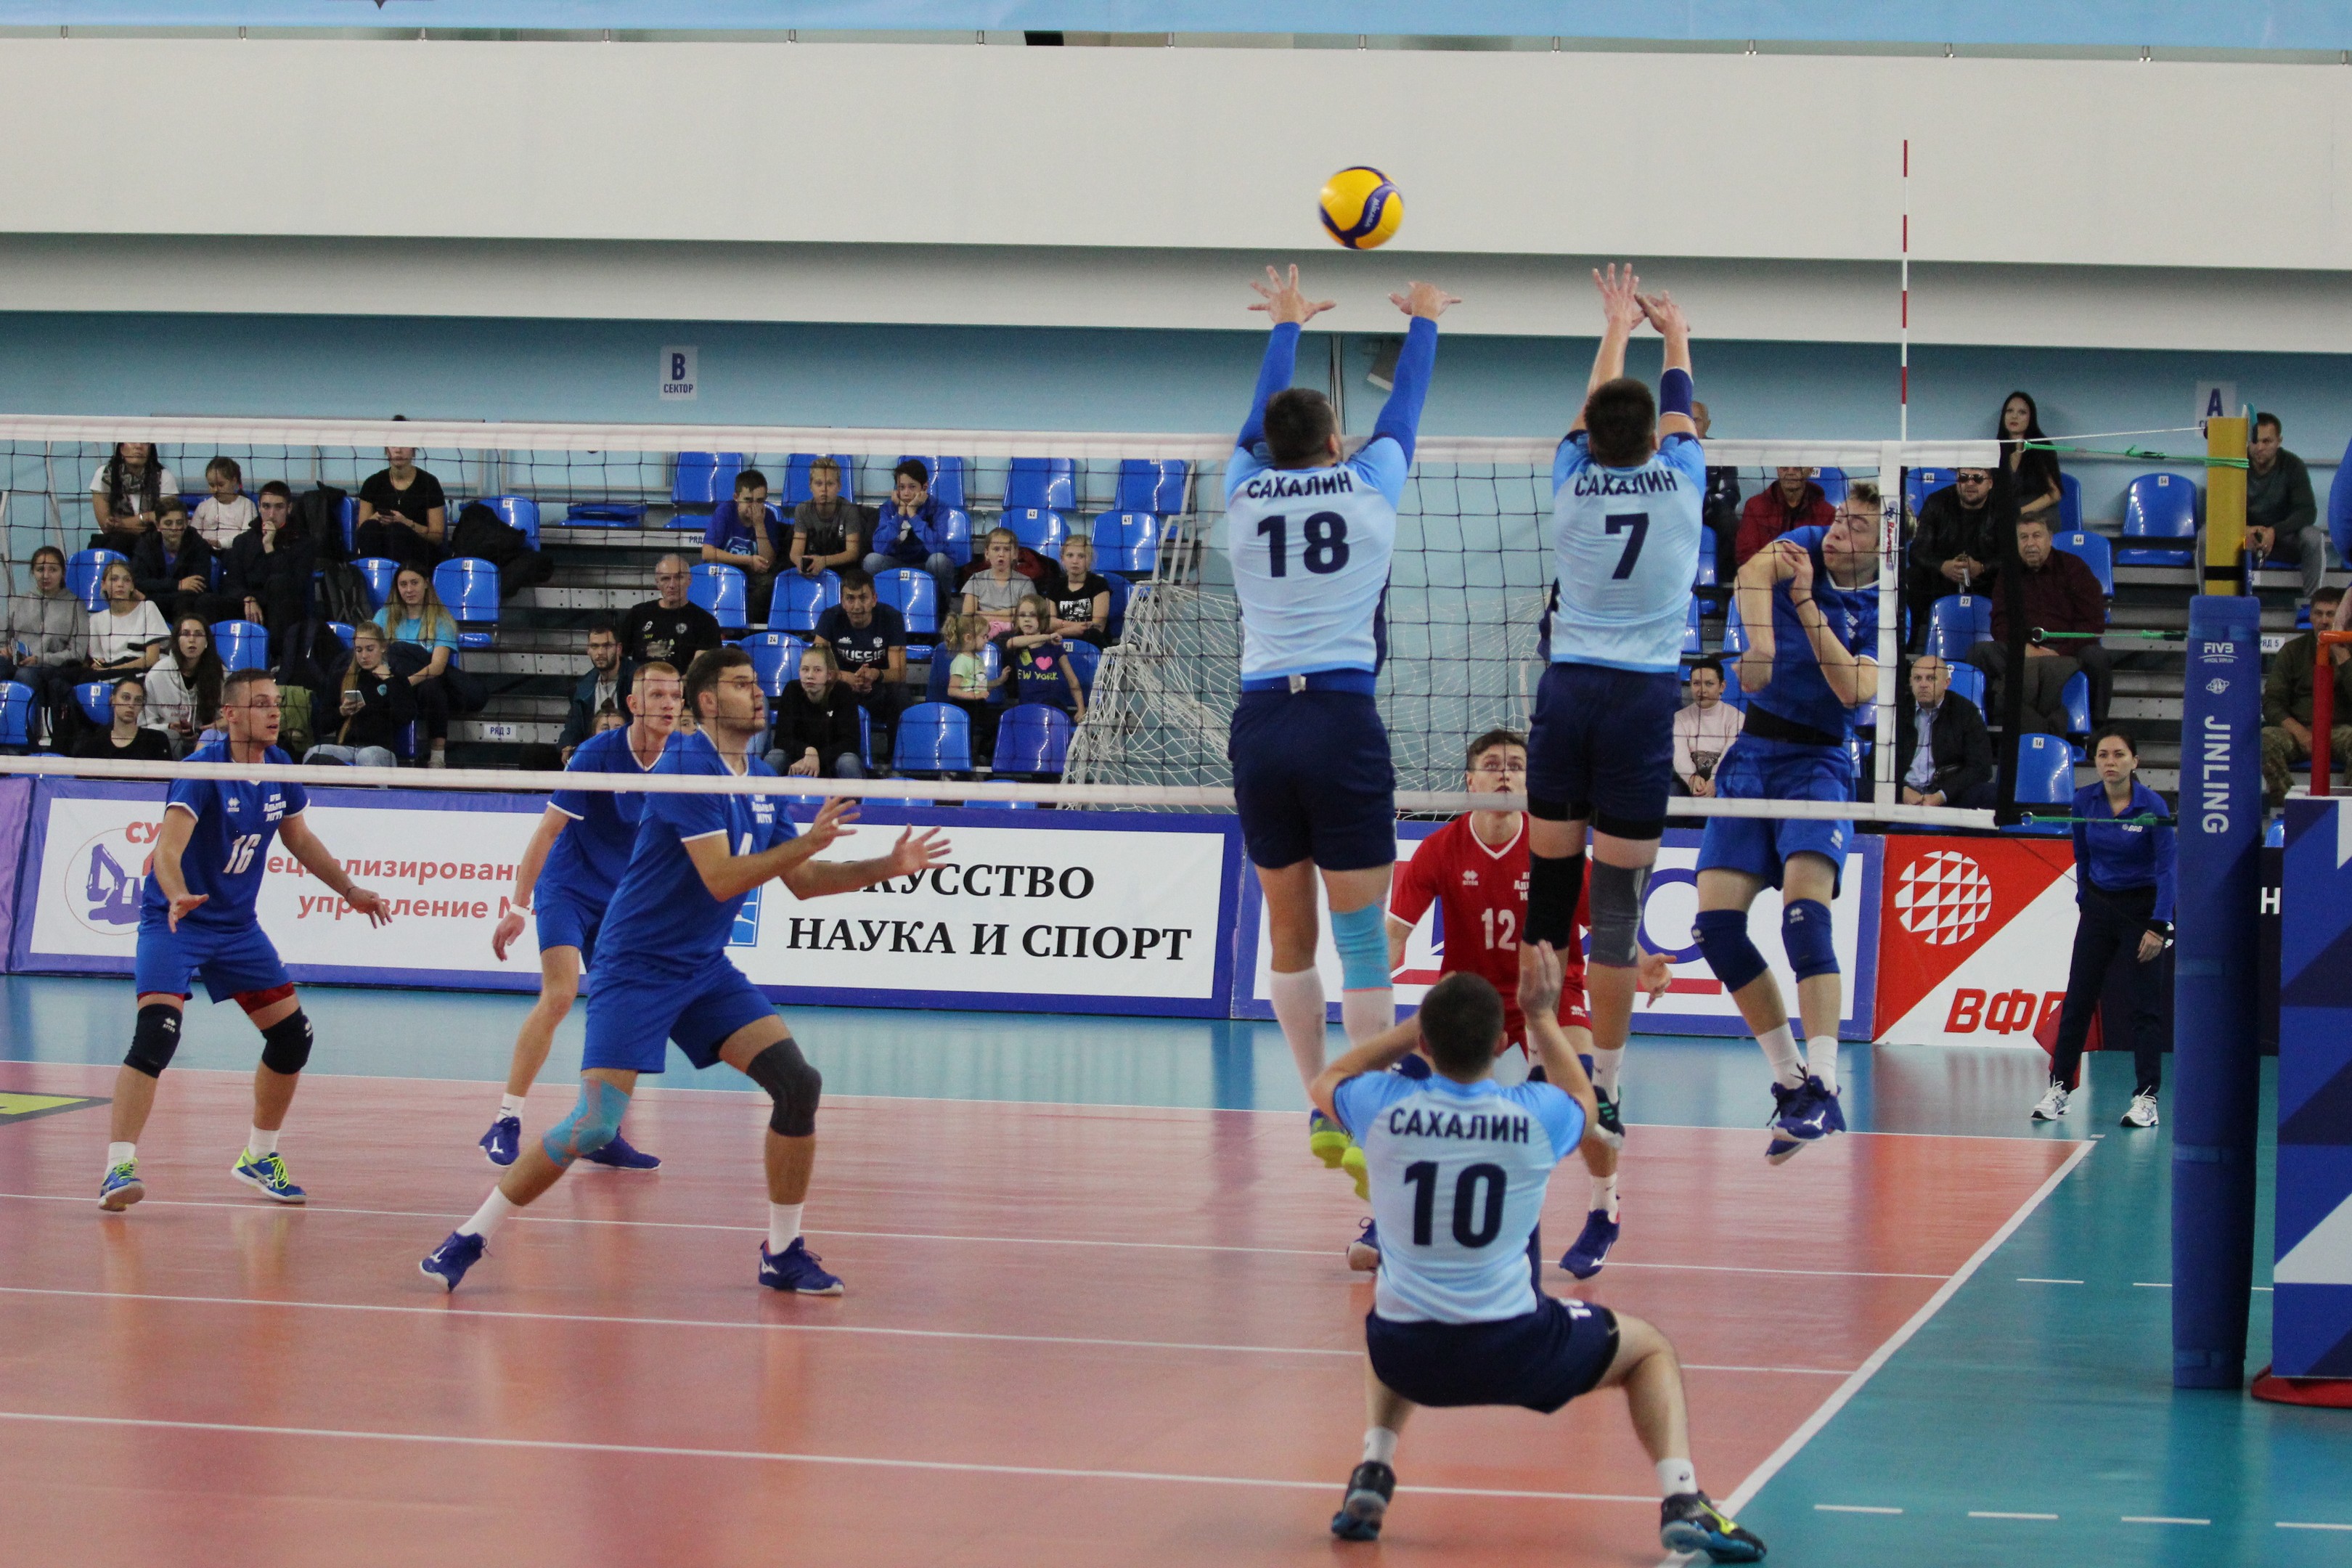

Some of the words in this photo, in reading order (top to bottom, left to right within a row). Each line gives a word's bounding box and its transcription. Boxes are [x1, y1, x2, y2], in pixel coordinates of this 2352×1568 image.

[672, 353, 686, 380] В
[663, 384, 693, 393] СЕКТОР
[2207, 388, 2224, 417] А
[1246, 471, 1353, 499] САХАЛИН
[1574, 470, 1678, 497] САХАЛИН
[689, 535, 703, 545] РЯД
[1257, 510, 1349, 578] 18
[1605, 513, 1649, 580] 7
[1064, 642, 1072, 651] 21
[2204, 642, 2234, 653] FIVB
[490, 727, 505, 735] РЯД
[2202, 715, 2231, 834] JINLING
[222, 833, 262, 874] 16
[267, 856, 523, 885] ецлизирован
[817, 860, 1095, 899] УССТВО
[297, 895, 489, 920] упрление
[786, 918, 956, 954] НАУКА
[970, 923, 1010, 956] И
[1022, 925, 1192, 960] СПОРТ
[1481, 907, 1517, 951] 12
[1389, 1107, 1530, 1144] САХАЛИН
[1404, 1161, 1507, 1249] 10
